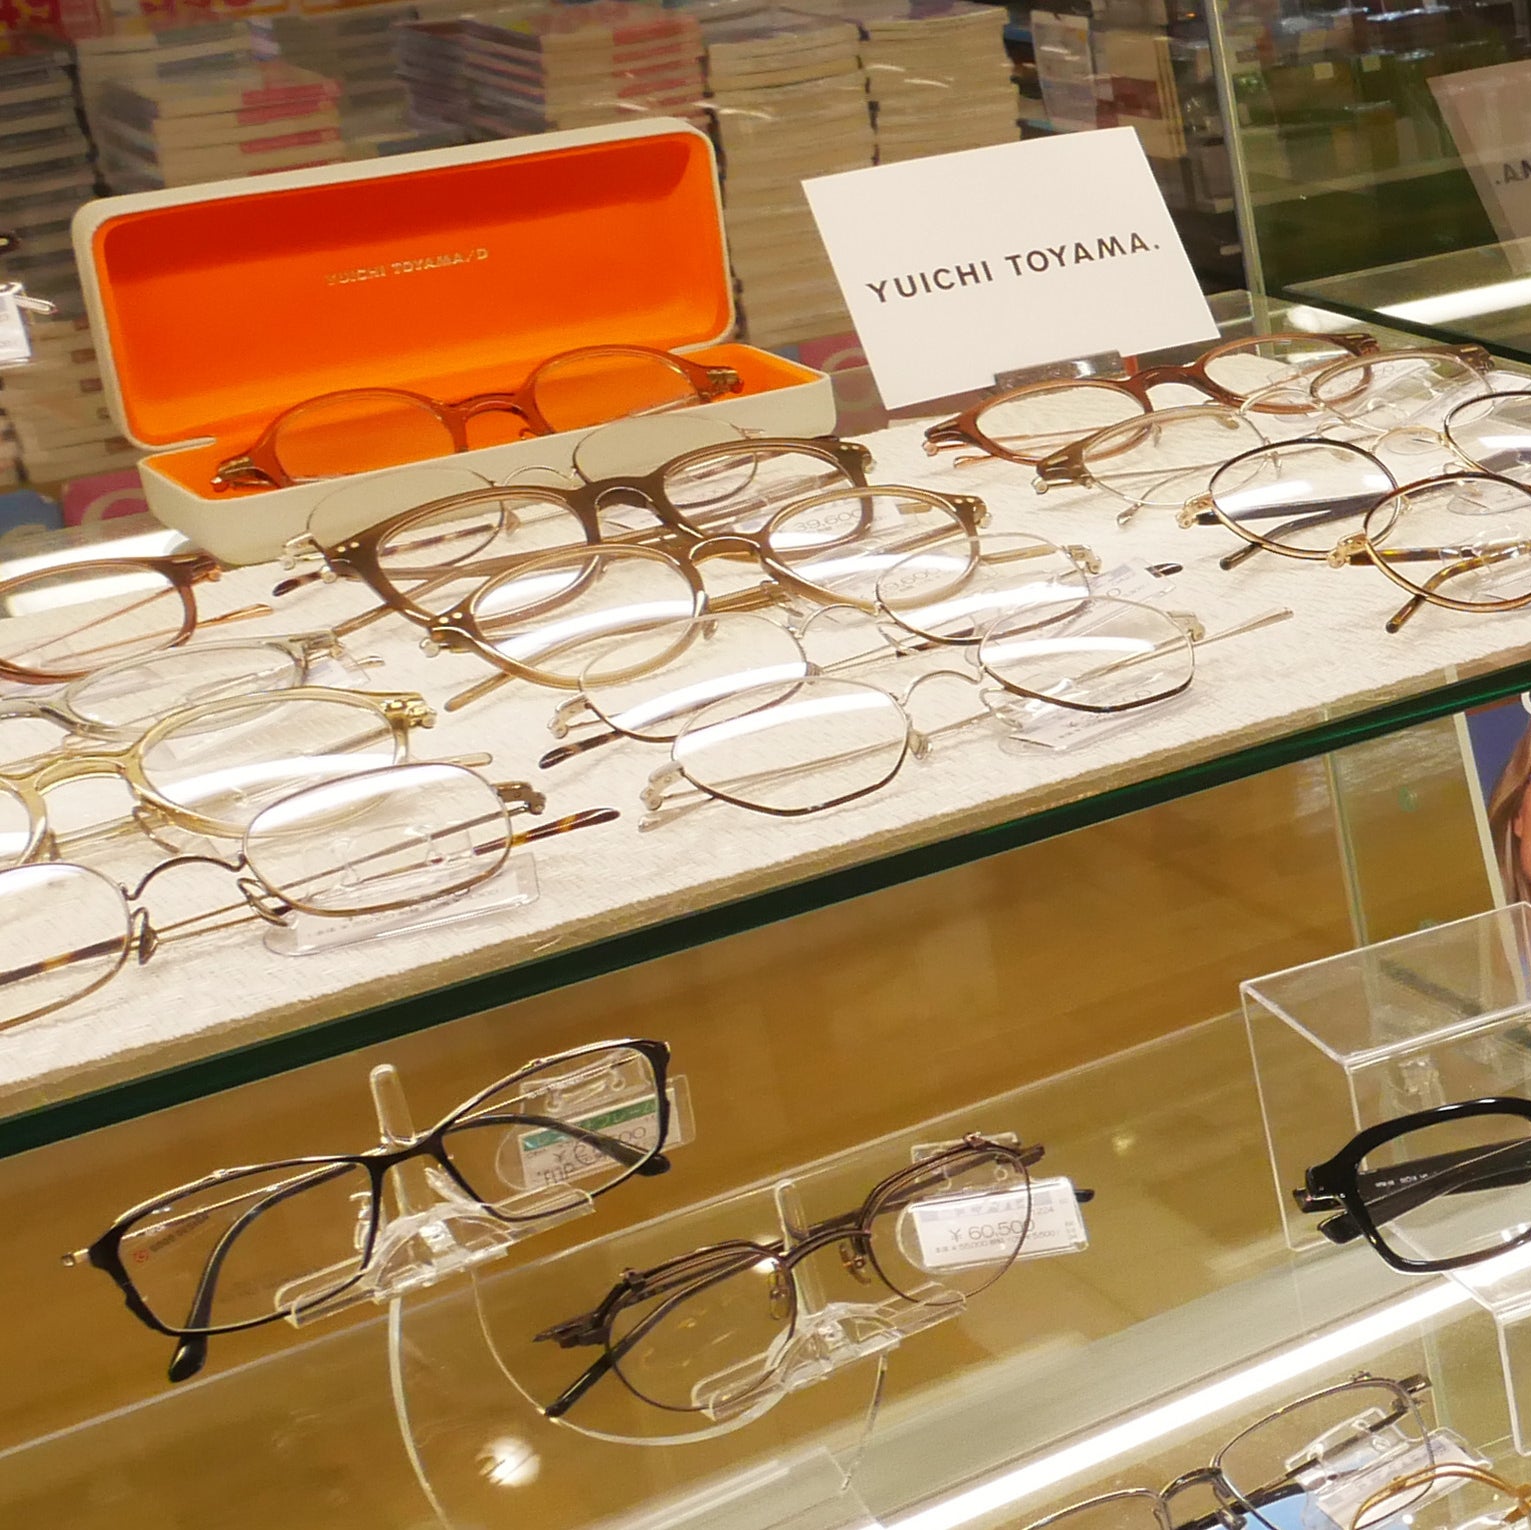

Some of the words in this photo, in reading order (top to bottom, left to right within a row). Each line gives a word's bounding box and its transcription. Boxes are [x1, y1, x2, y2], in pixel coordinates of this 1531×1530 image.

[866, 259, 994, 303] YUICHI
[1005, 231, 1161, 277] TOYAMA.
[968, 1219, 1035, 1240] 60,500
